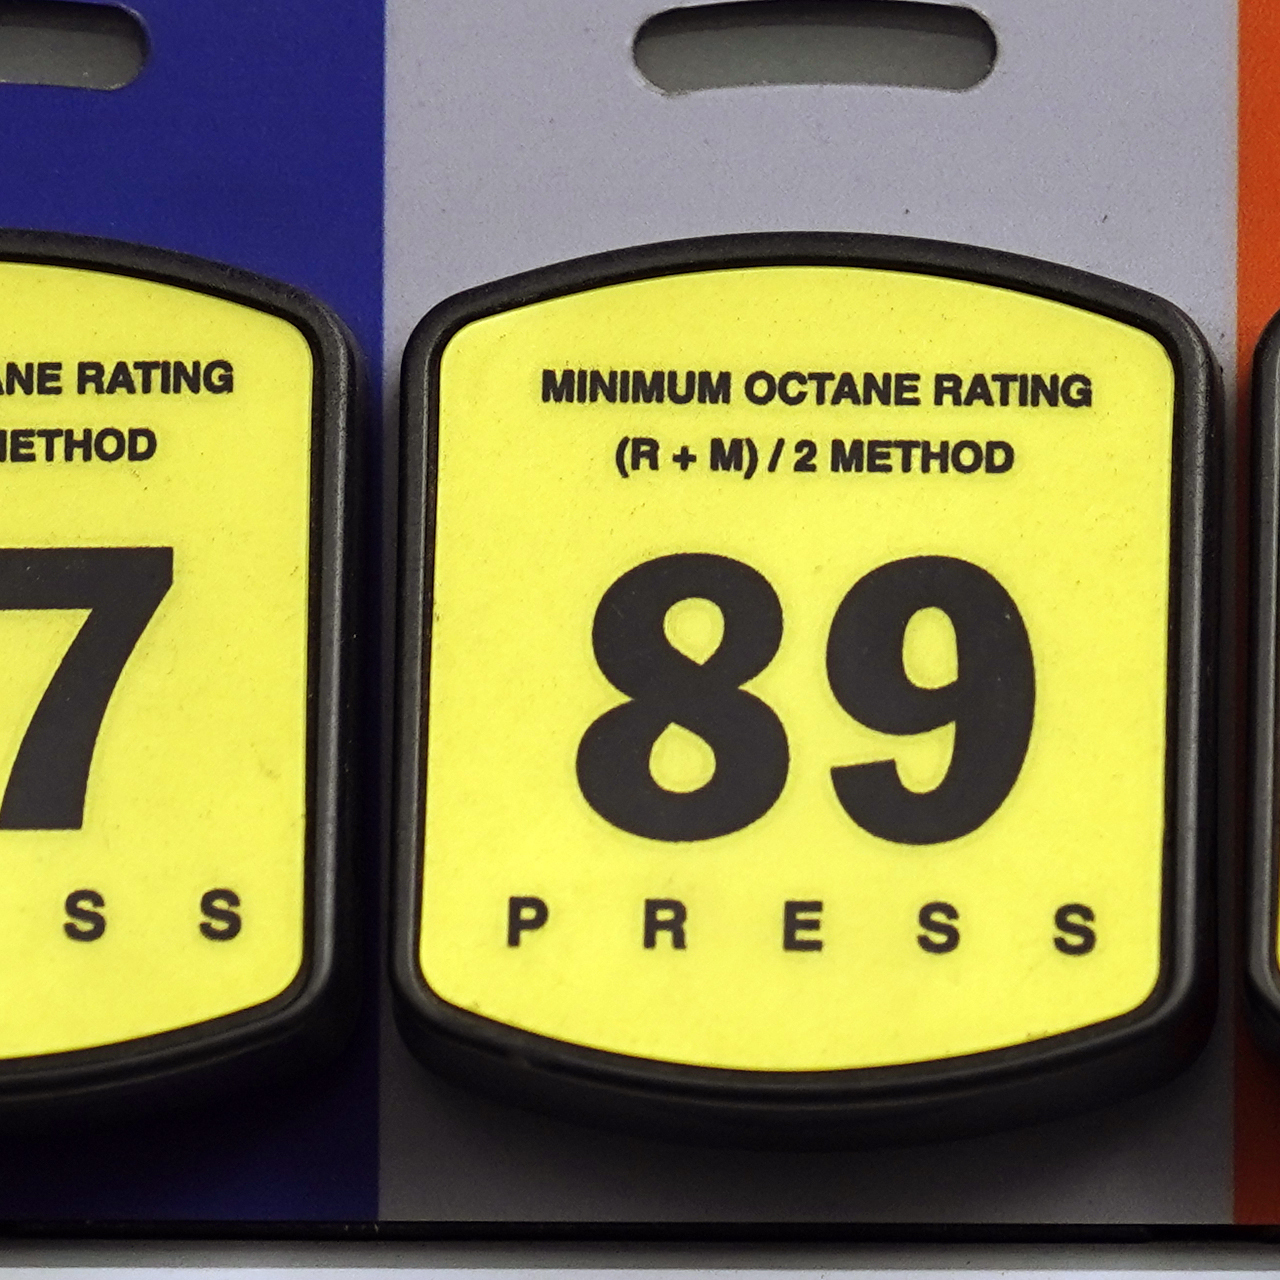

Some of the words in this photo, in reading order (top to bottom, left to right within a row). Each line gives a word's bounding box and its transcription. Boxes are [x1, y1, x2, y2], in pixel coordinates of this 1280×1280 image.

[75, 361, 236, 396] RATING
[542, 370, 732, 407] MINIMUM
[744, 372, 921, 407] OCTANE
[934, 372, 1094, 408] RATING
[615, 439, 660, 479] (R
[709, 439, 760, 477] M)
[793, 441, 817, 472] 2
[830, 439, 1016, 475] METHOD
[574, 552, 1037, 846] 89
